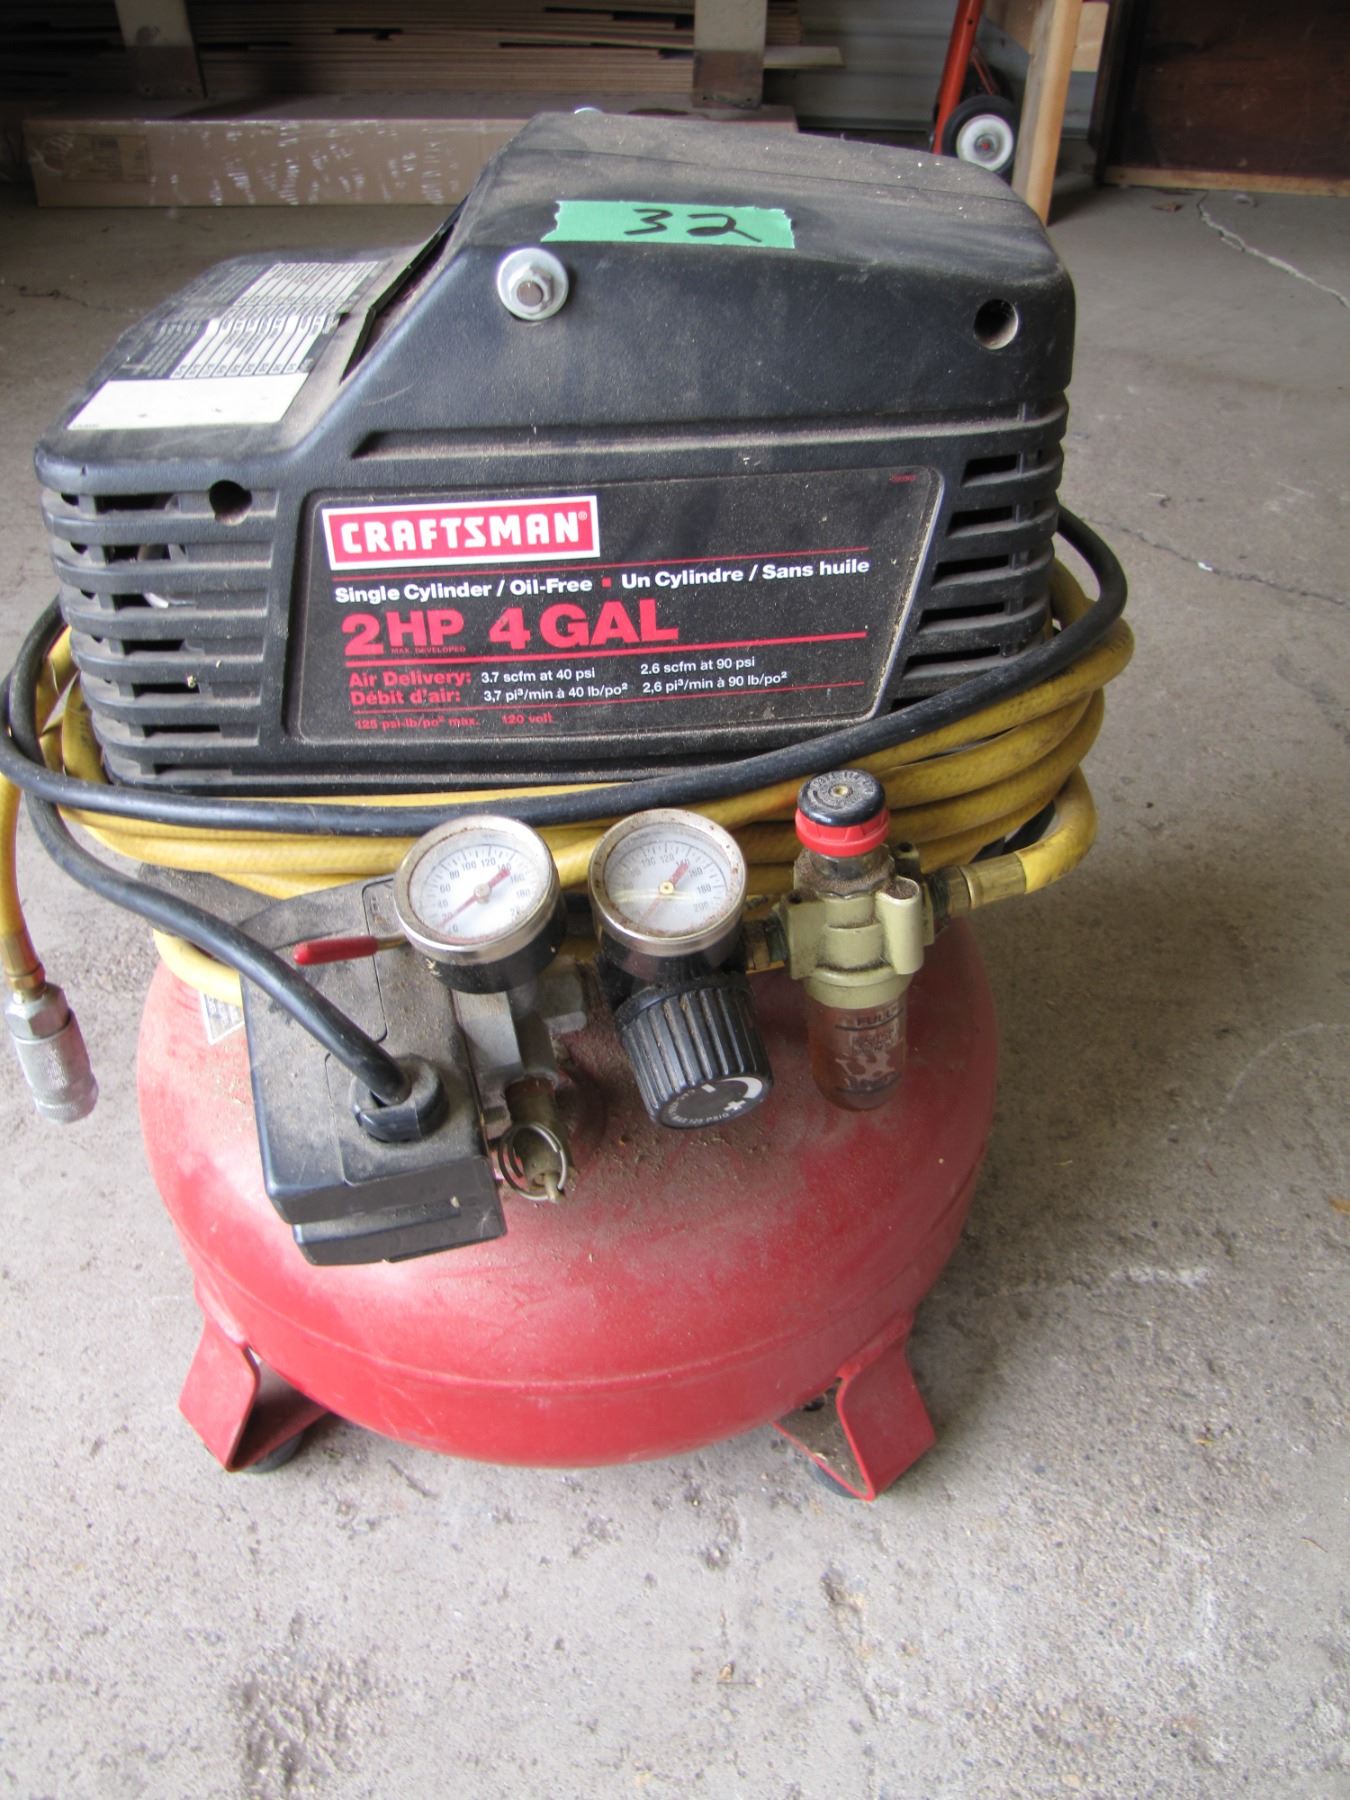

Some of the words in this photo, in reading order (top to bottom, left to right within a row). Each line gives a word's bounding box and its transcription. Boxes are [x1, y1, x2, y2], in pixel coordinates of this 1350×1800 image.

[624, 208, 762, 243] 32
[621, 573, 651, 590] Un
[654, 566, 744, 590] Cylindre
[761, 562, 814, 581] Sans
[819, 558, 870, 577] huile
[335, 585, 400, 605] Single
[403, 580, 492, 603] Cylinder
[509, 576, 593, 597] Oil-Free
[539, 597, 679, 649] GAL
[640, 662, 660, 675] 2.6
[663, 660, 697, 674] scfm
[700, 659, 714, 672] at
[716, 657, 733, 670] 90
[735, 655, 756, 670] psi
[349, 671, 377, 688] Air
[382, 669, 472, 688] Delivery:
[481, 671, 499, 684] 3.7
[503, 669, 537, 683] scfm
[539, 669, 553, 682] at
[556, 668, 572, 680] 40
[575, 666, 596, 682] psi
[483, 689, 502, 703] 3,7
[568, 686, 584, 698] 40
[642, 681, 663, 695] 2,6
[716, 677, 725, 688] à
[728, 675, 745, 687] 90
[350, 689, 405, 706] Débit
[409, 687, 462, 704] d'air:
[502, 714, 525, 726] 120
[528, 712, 554, 724] volt
[461, 860, 477, 872] 100
[480, 856, 496, 868] 120
[439, 883, 451, 894] 60
